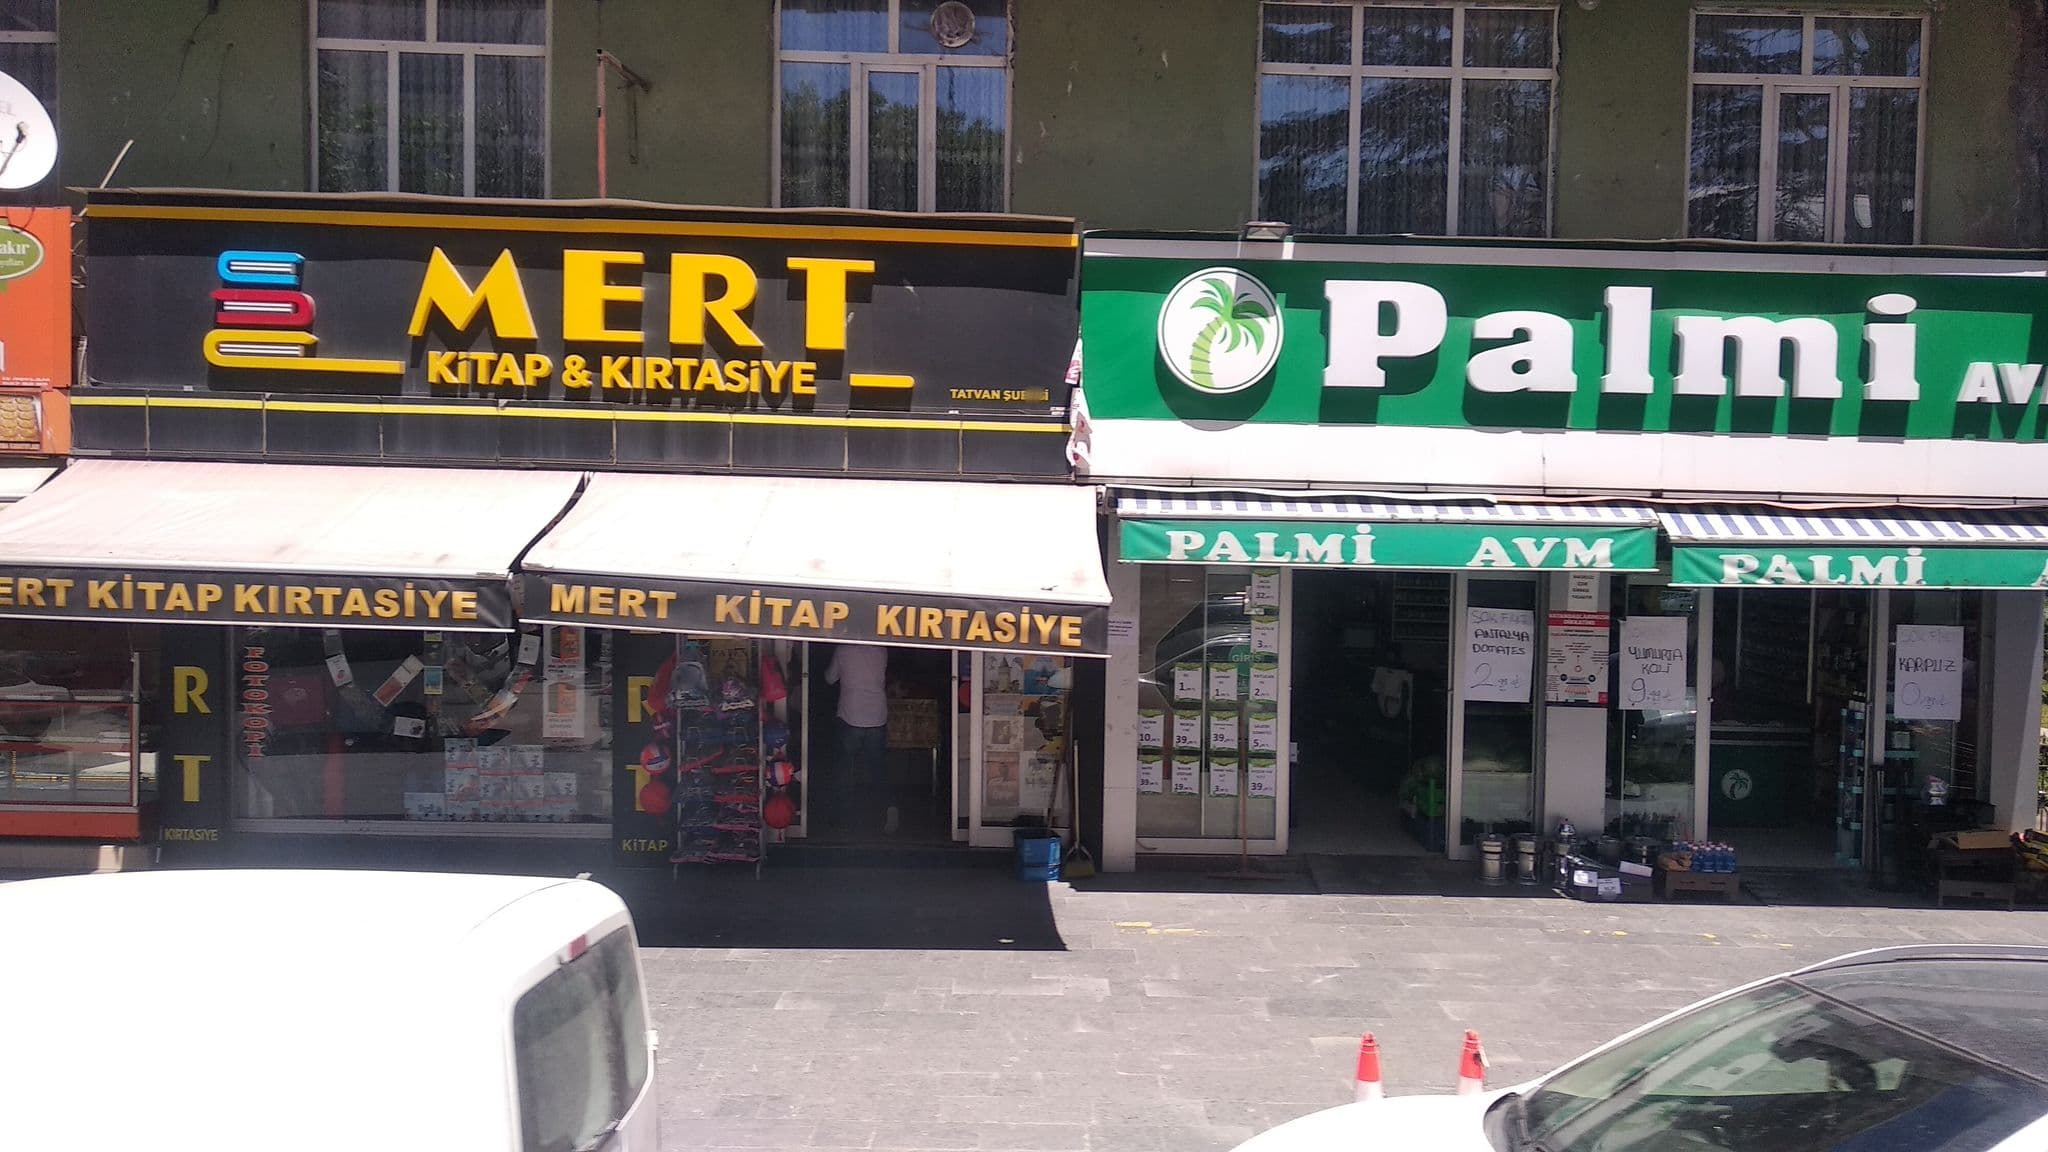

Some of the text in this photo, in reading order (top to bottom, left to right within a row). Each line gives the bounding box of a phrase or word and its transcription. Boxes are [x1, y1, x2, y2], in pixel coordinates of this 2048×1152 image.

[408, 246, 876, 350] MERT
[1324, 279, 2048, 405] Palmi AV
[560, 355, 593, 389] &
[949, 388, 1001, 400] TATVAN
[1166, 524, 1613, 568] PALMİ AVM
[1718, 547, 1926, 585] PALMİ
[87, 573, 223, 614] KİTAP
[234, 577, 479, 621] KIRTASİYE
[551, 583, 677, 620] MERT
[714, 589, 850, 630] KİTAP
[877, 605, 1083, 647] KIRTASİYE
[1899, 657, 1957, 672] KARPUZ
